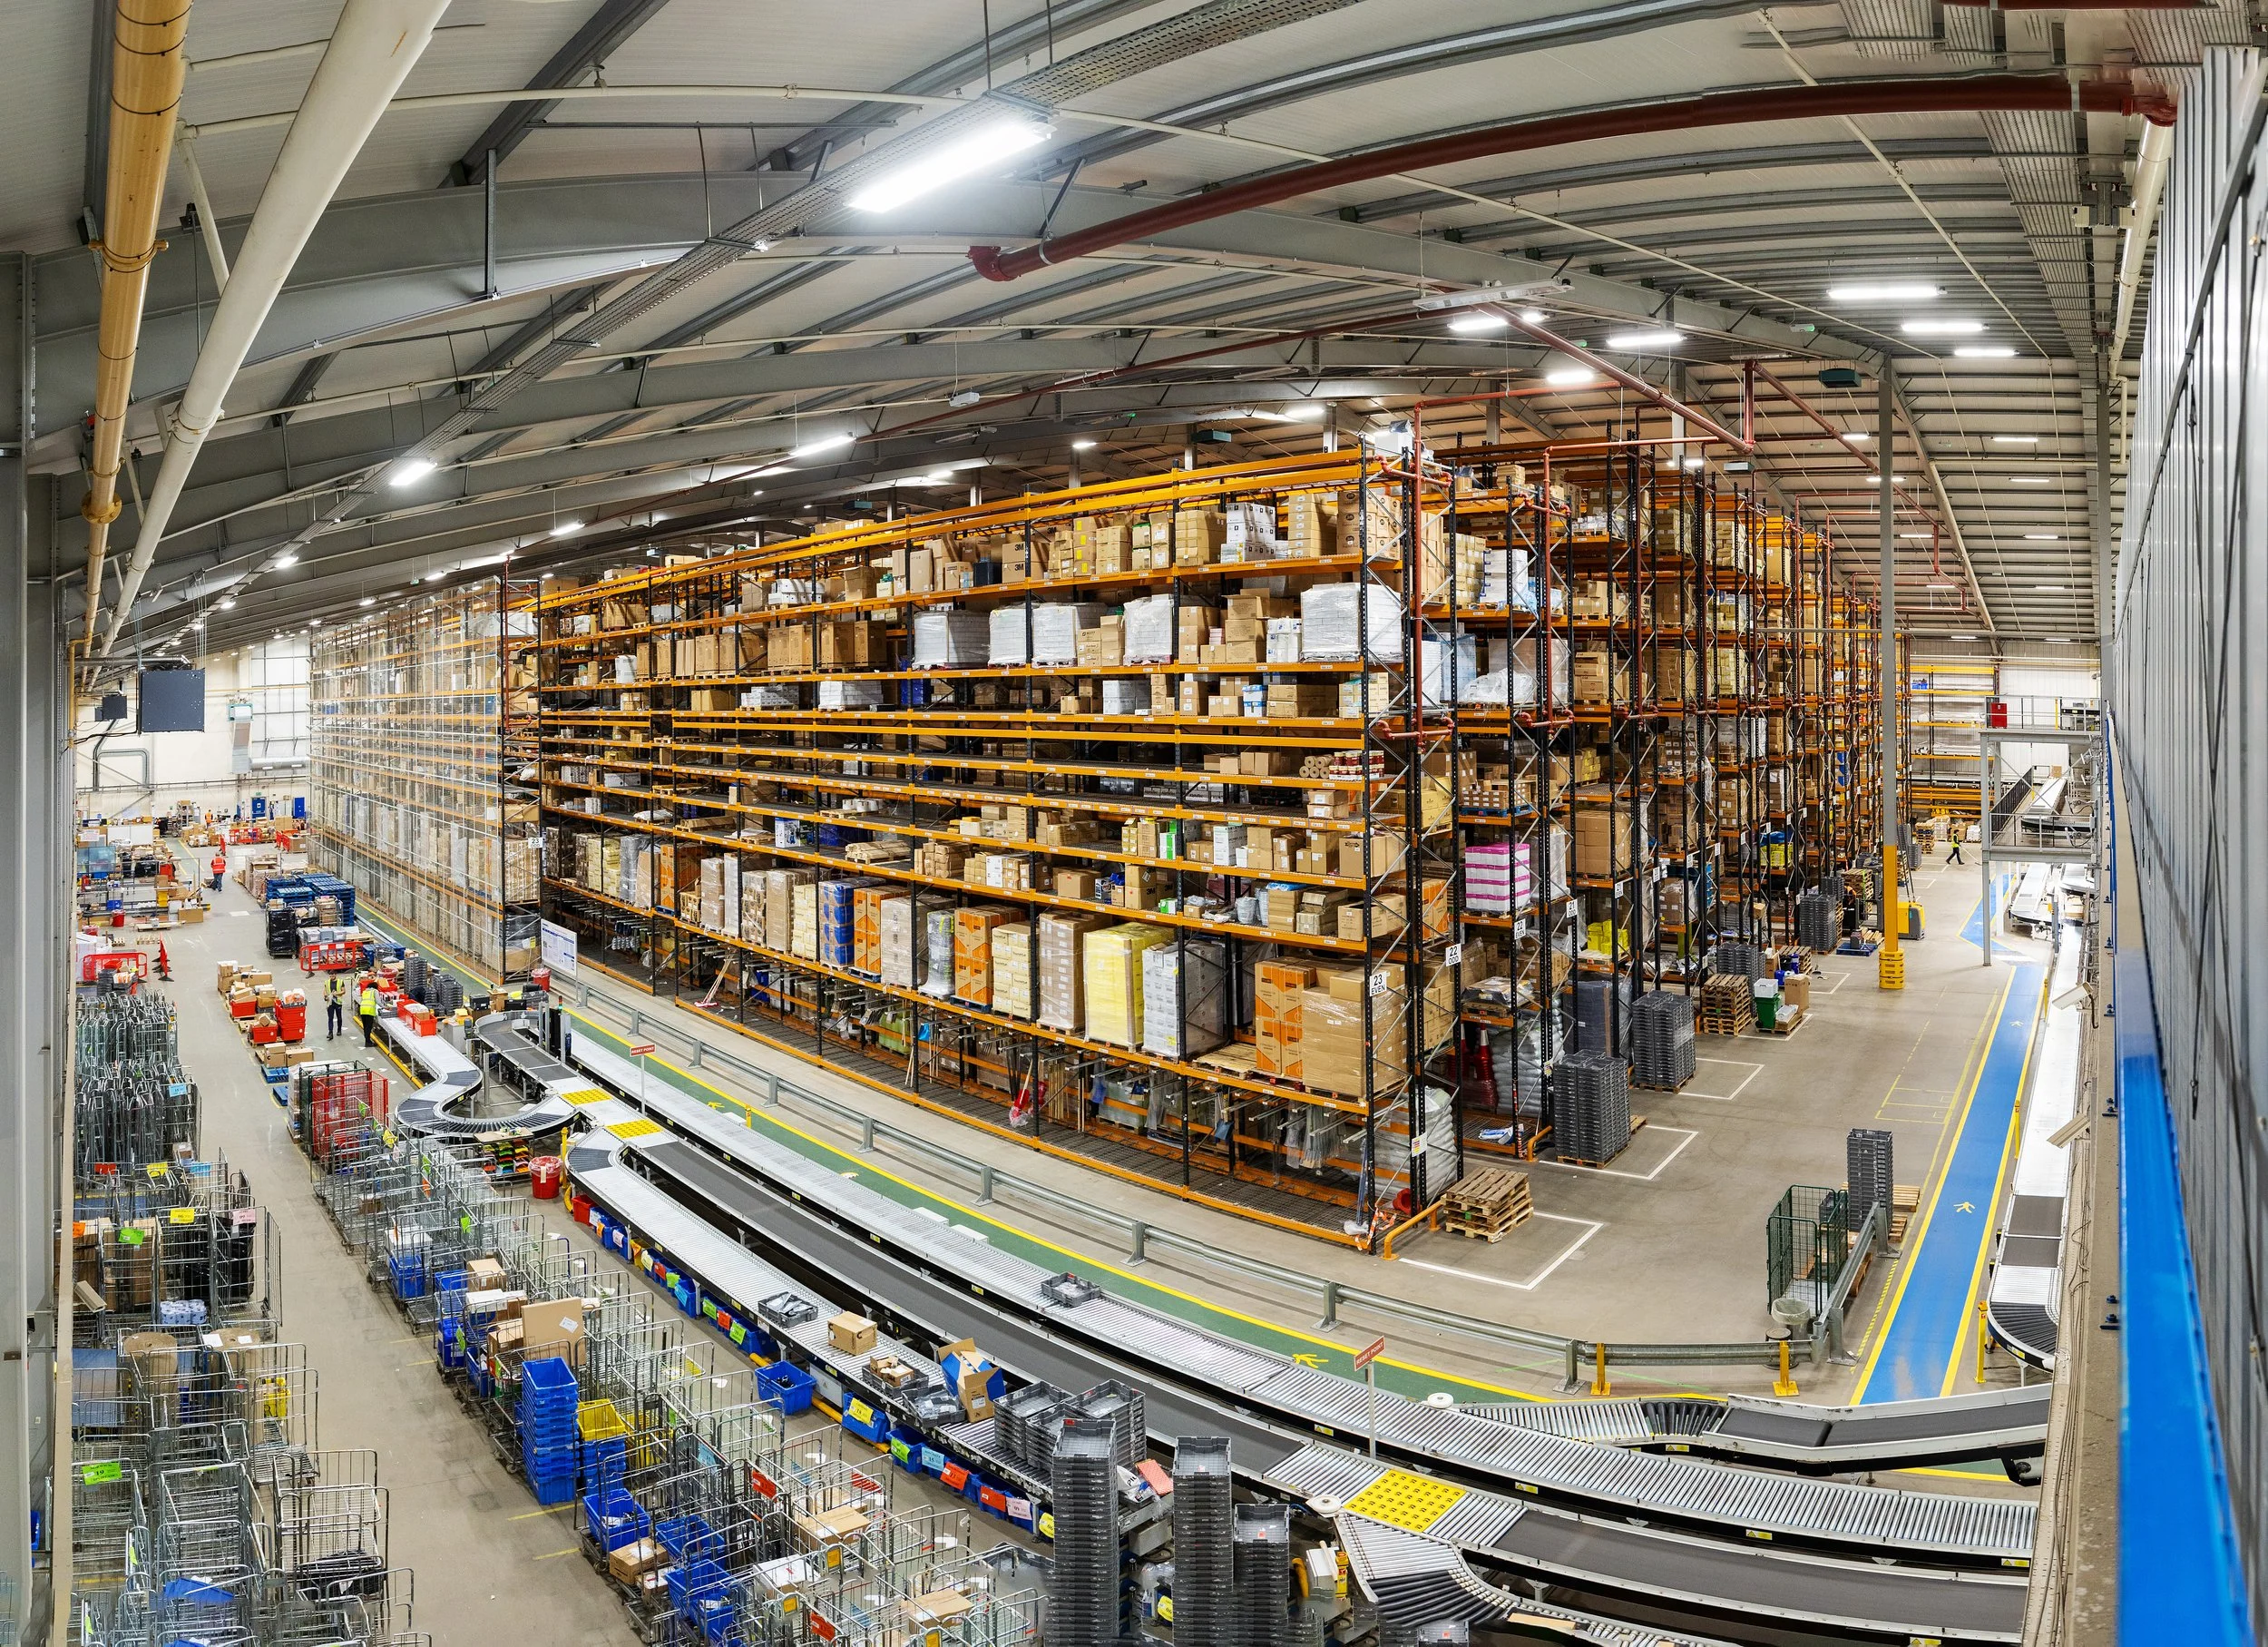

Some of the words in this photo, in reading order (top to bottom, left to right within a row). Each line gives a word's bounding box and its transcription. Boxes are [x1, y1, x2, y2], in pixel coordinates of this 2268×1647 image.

[1014, 544, 1024, 552] 3M
[1014, 564, 1024, 572] 3M
[1569, 900, 1575, 910] 21
[1516, 921, 1523, 931] 22
[1515, 930, 1525, 939] EVEN
[1449, 946, 1458, 956] 22
[1448, 956, 1459, 965] ODD
[1374, 974, 1383, 986] 23
[1371, 984, 1385, 995] EVEN
[1356, 1350, 1371, 1365] RESET
[1371, 1341, 1384, 1355] POINT
